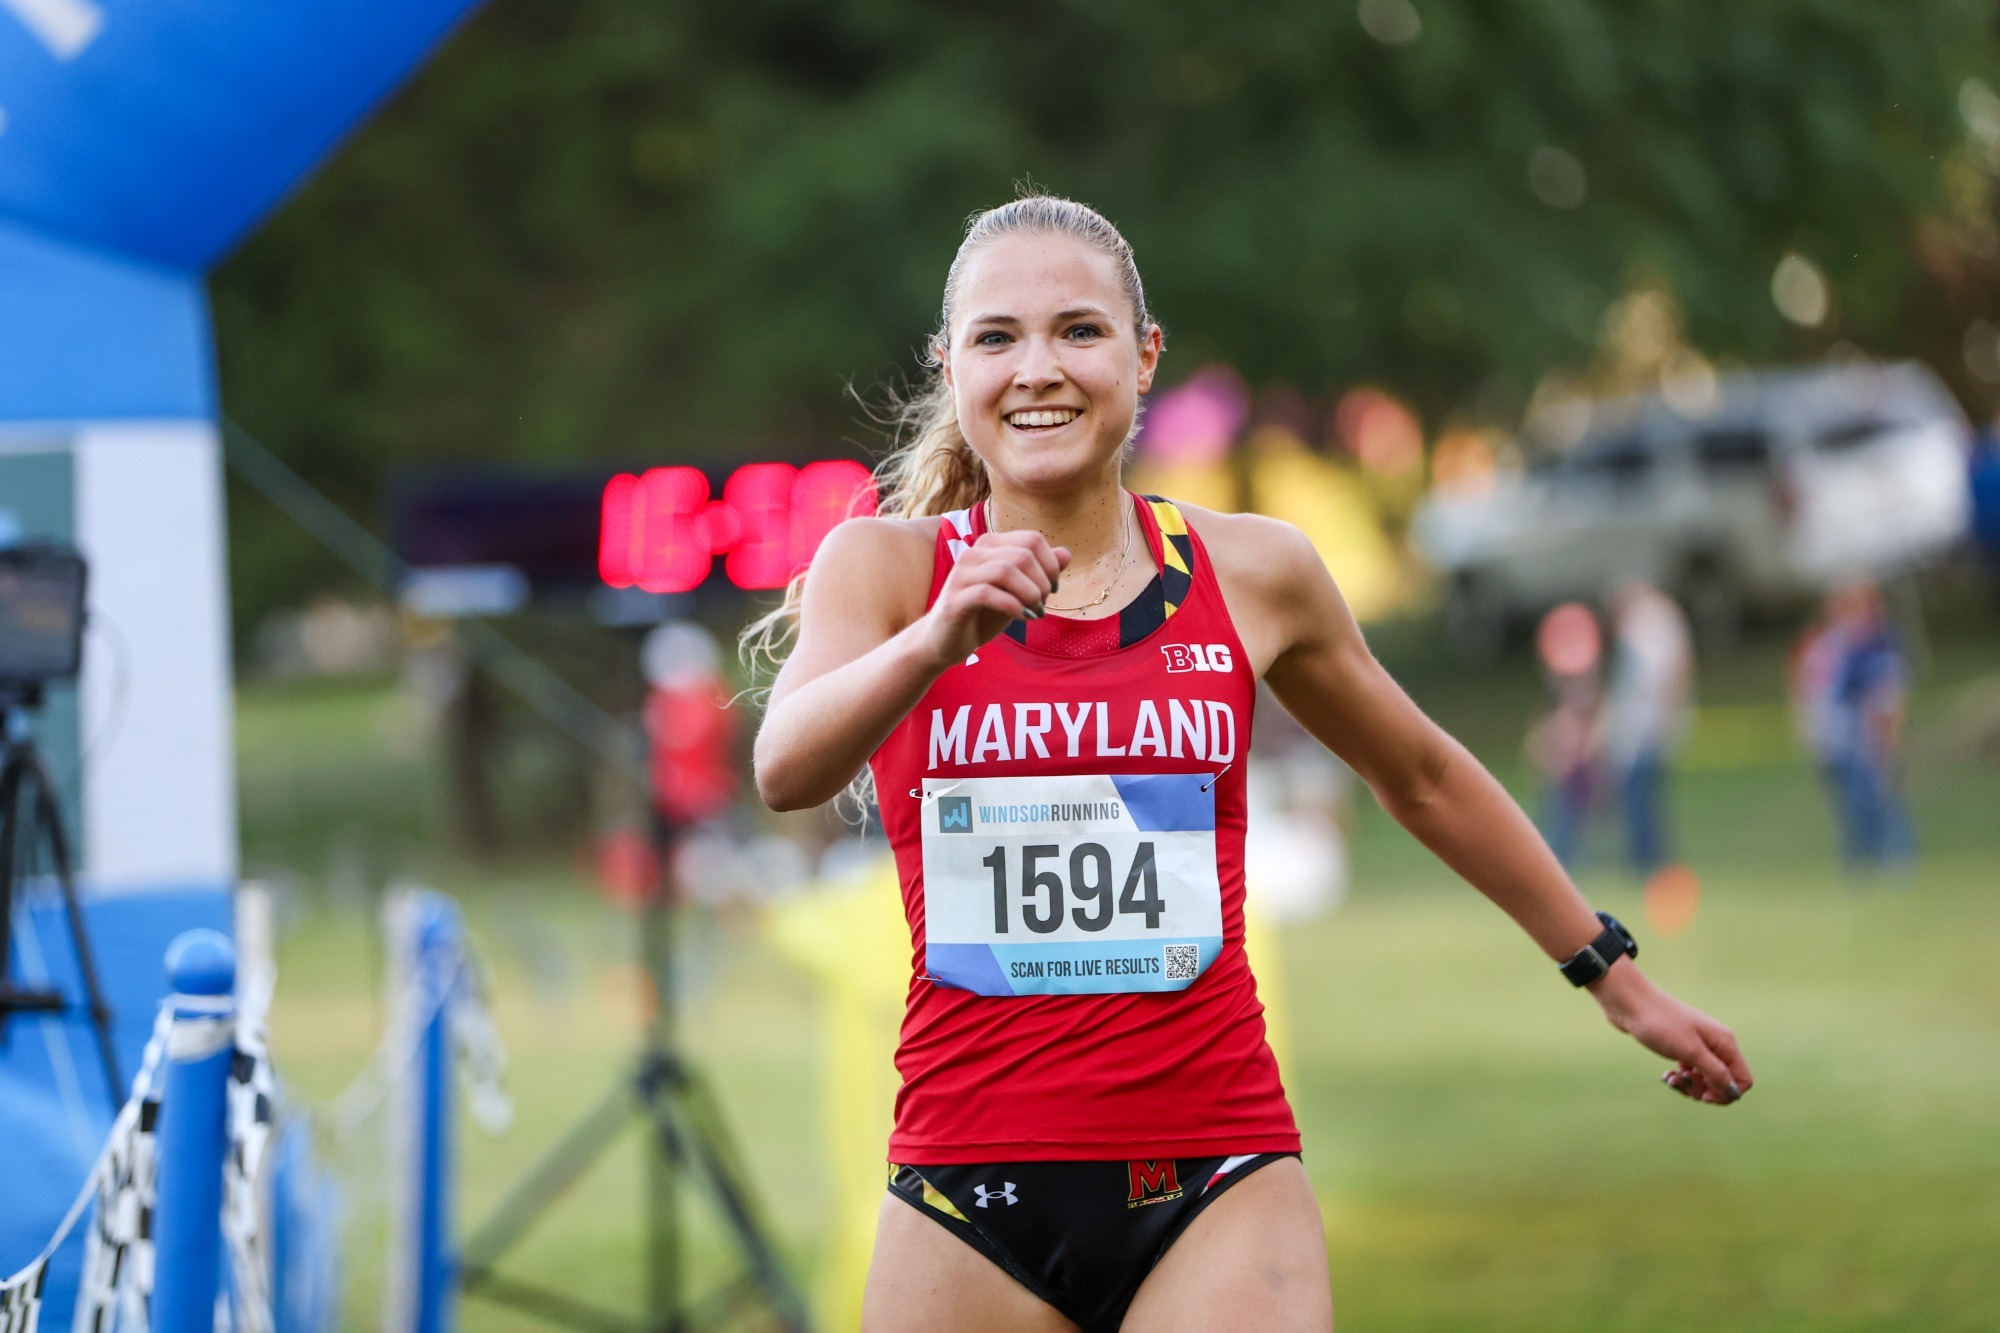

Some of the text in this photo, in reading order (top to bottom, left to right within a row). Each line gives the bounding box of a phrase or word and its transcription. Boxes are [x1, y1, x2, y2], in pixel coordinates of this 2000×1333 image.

[927, 698, 1236, 771] MARYLAND
[982, 841, 1166, 934] 1594
[1010, 957, 1160, 978] SCAN FOR LIVE RESULTS
[1127, 1158, 1183, 1202] M
